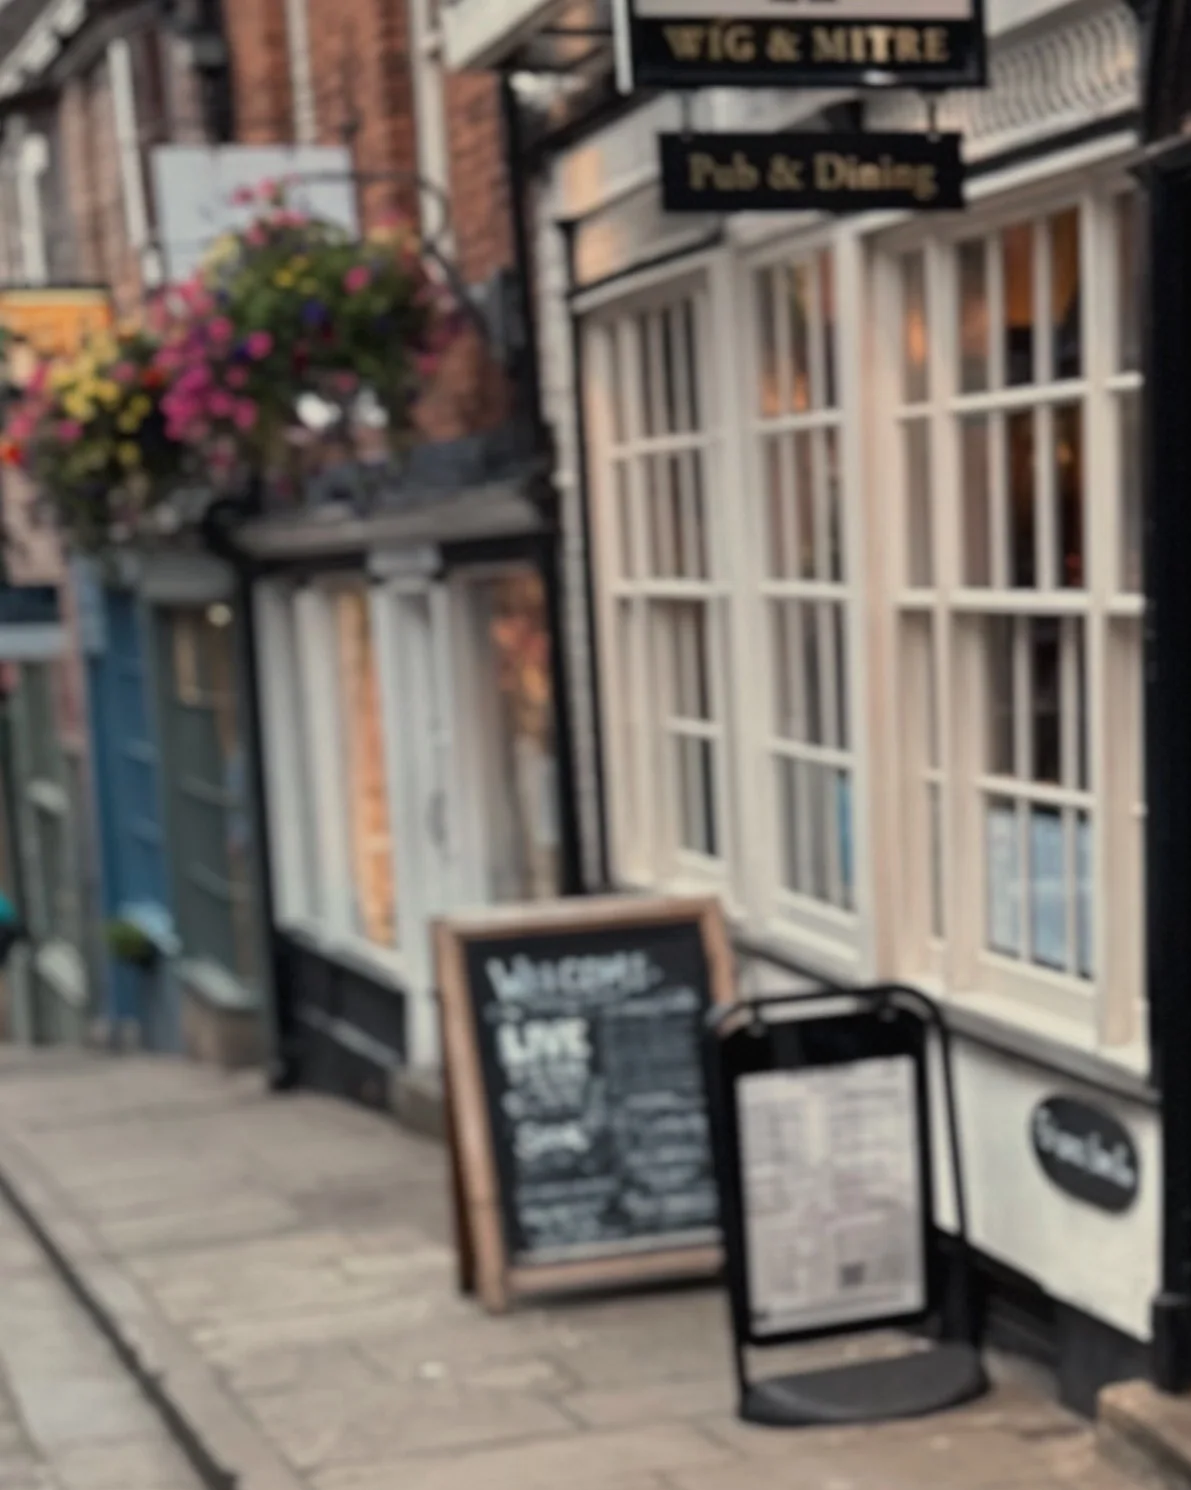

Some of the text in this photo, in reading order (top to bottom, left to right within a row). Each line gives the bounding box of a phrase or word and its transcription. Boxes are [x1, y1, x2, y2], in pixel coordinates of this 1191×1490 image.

[661, 25, 951, 63] WIG & MITRE
[688, 152, 939, 200] Pub & Dining
